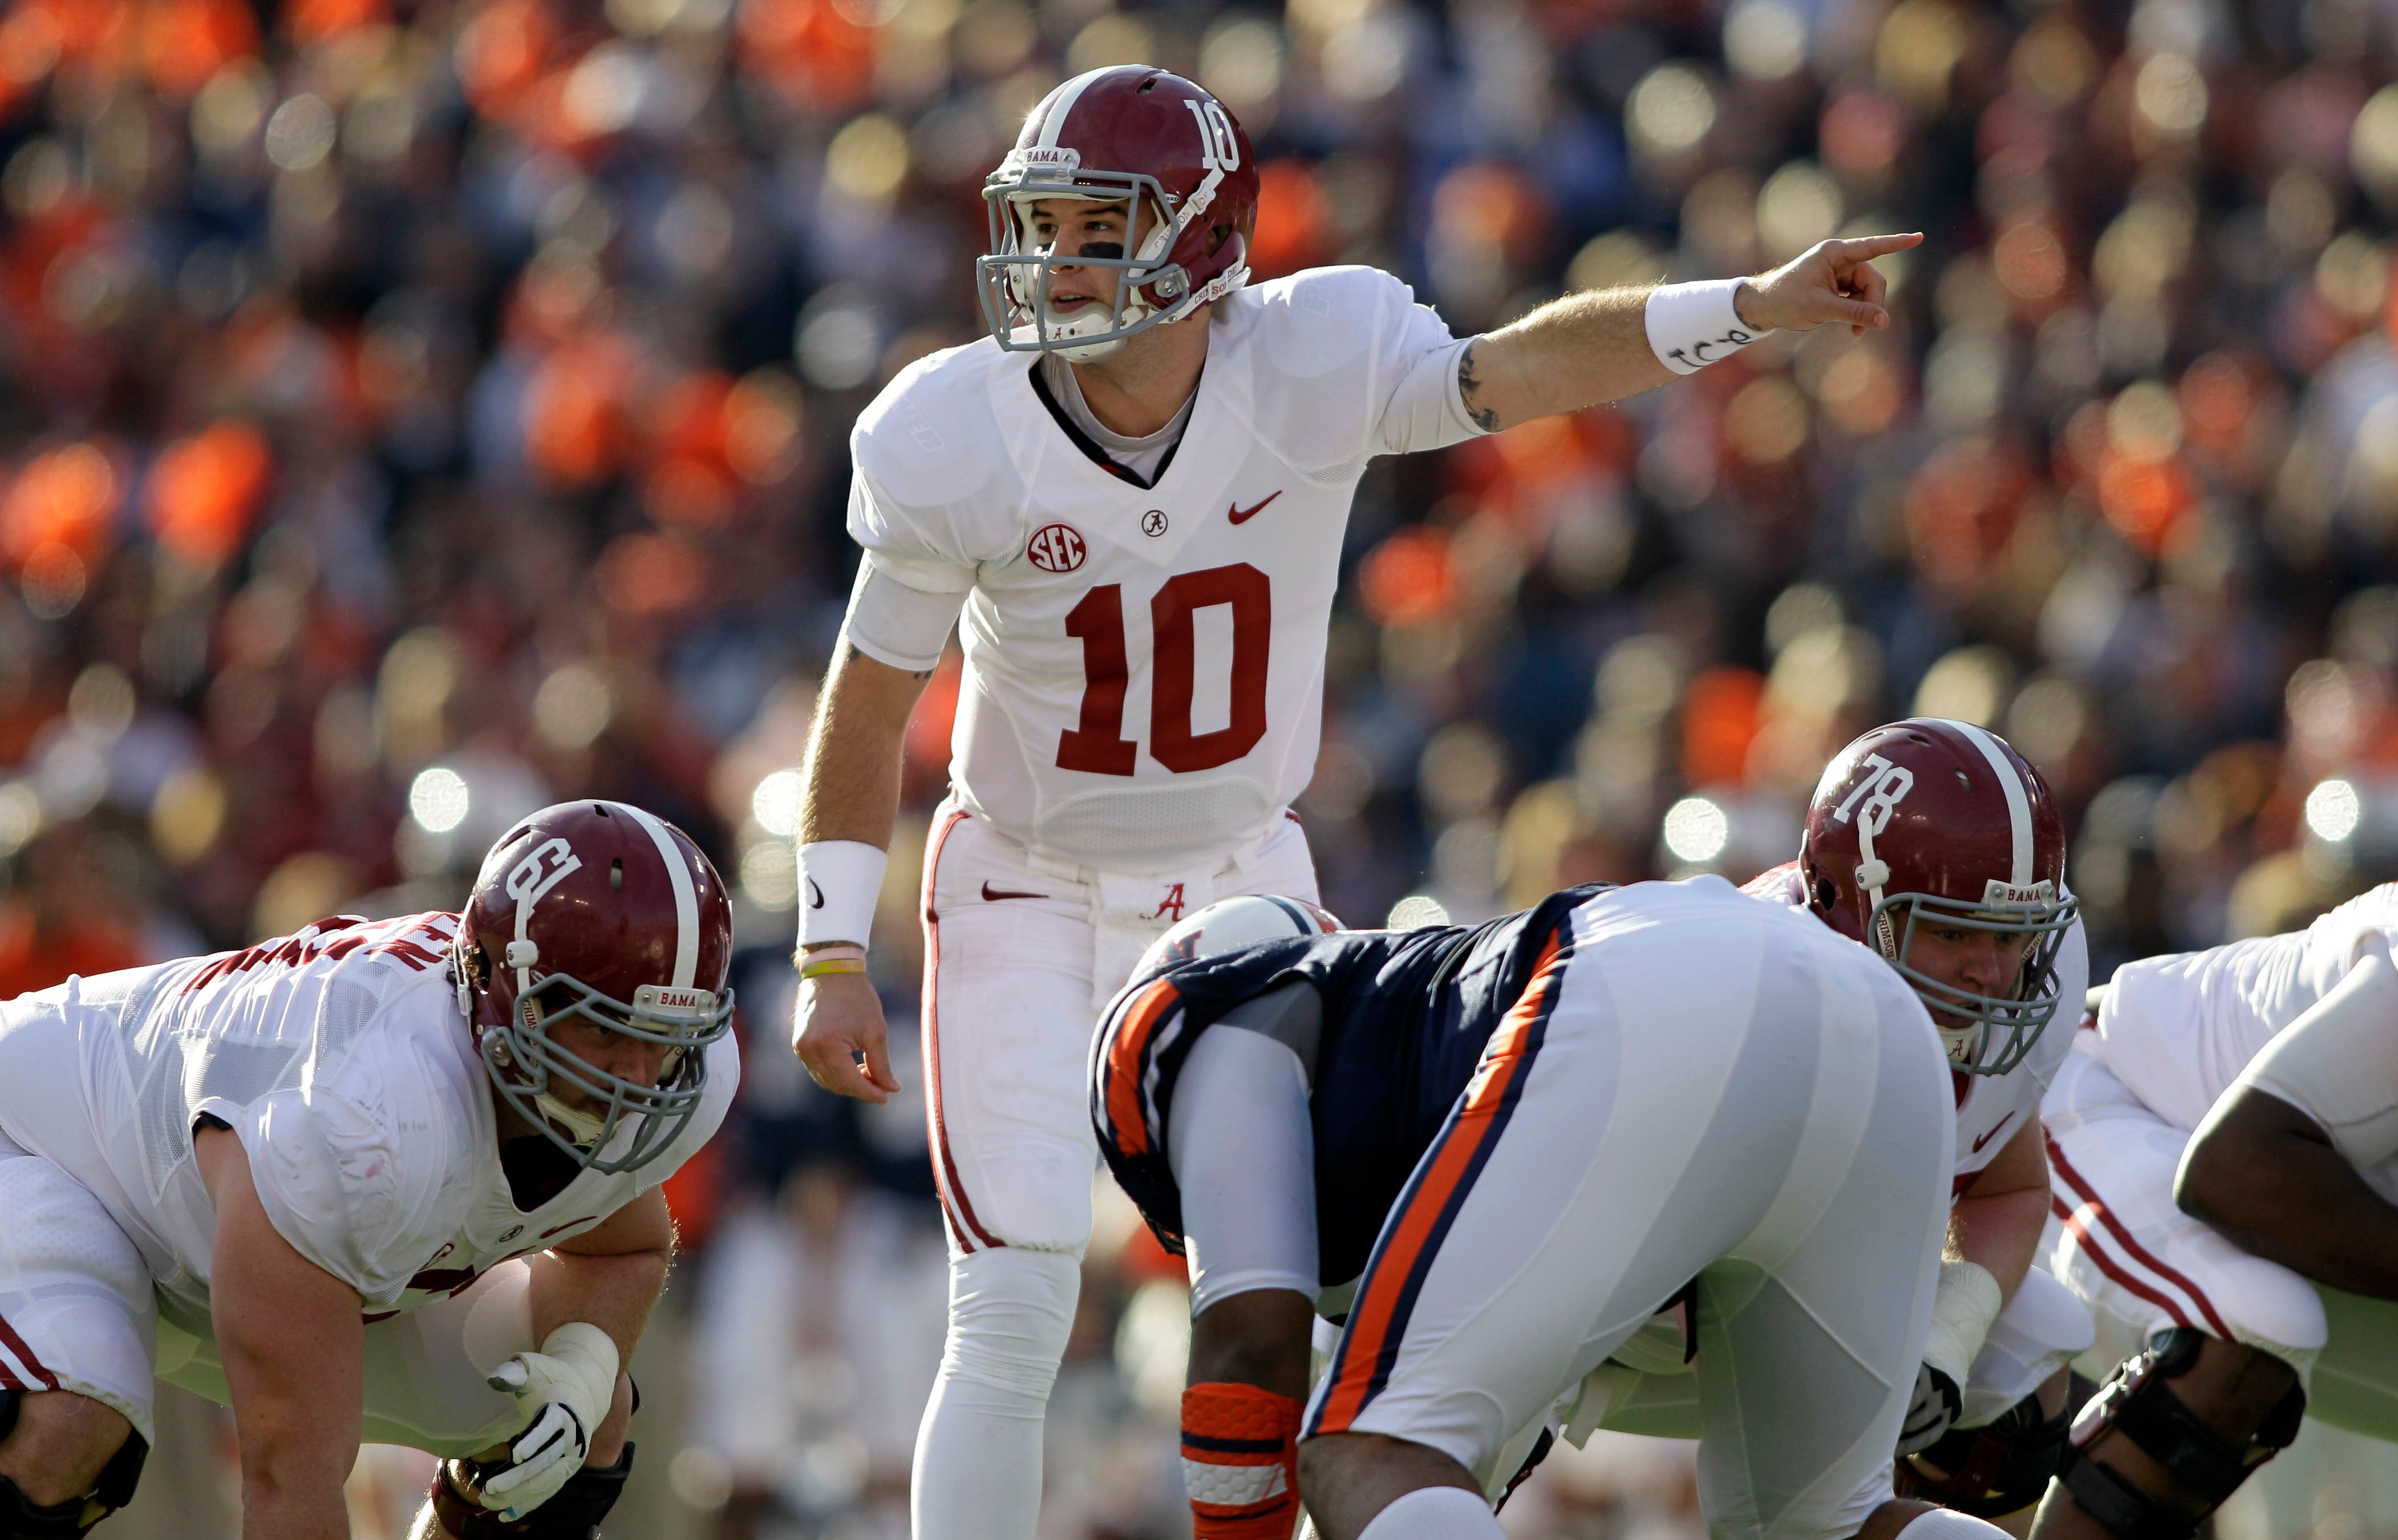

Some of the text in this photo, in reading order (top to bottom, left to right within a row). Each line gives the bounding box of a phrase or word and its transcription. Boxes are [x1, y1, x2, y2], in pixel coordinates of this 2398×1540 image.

[1183, 99, 1239, 171] 10
[1027, 151, 1058, 162] BAMA
[1053, 326, 1062, 339] A
[1147, 513, 1162, 533] A
[1031, 527, 1083, 570] SEC
[1056, 562, 1271, 776] 10
[1833, 753, 1914, 837] 78
[505, 838, 582, 920] 61
[2008, 889, 2040, 901] BAMA
[1139, 883, 1185, 922] A
[1878, 913, 1894, 961] CRIMSON
[660, 992, 695, 1007] BAMA
[1947, 1039, 1963, 1056] A
